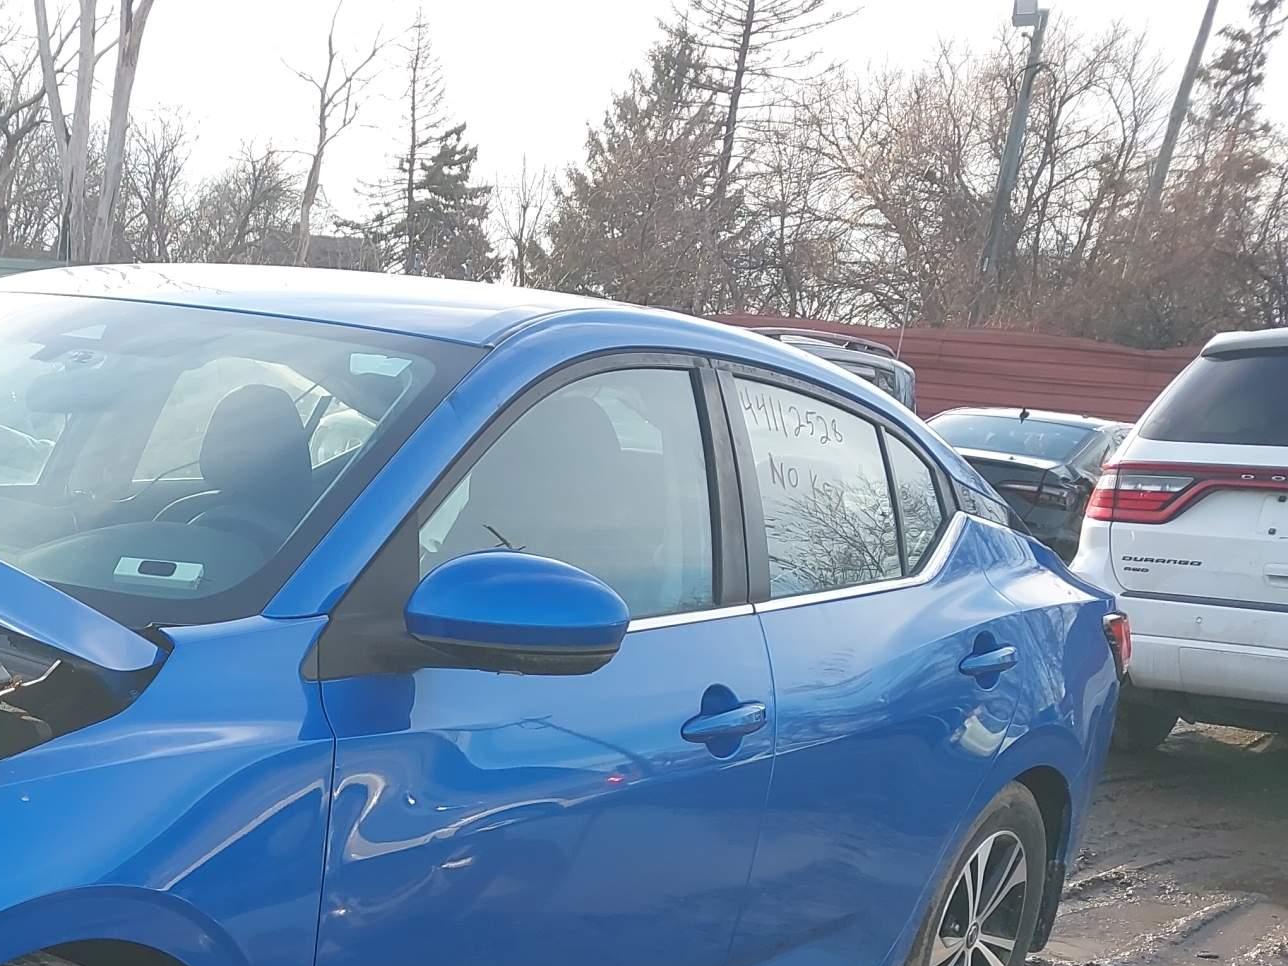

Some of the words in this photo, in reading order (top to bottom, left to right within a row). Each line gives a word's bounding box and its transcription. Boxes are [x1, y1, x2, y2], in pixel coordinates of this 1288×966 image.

[739, 386, 844, 445] 44112528
[768, 451, 799, 491] NO
[1121, 555, 1203, 567] DURANGO
